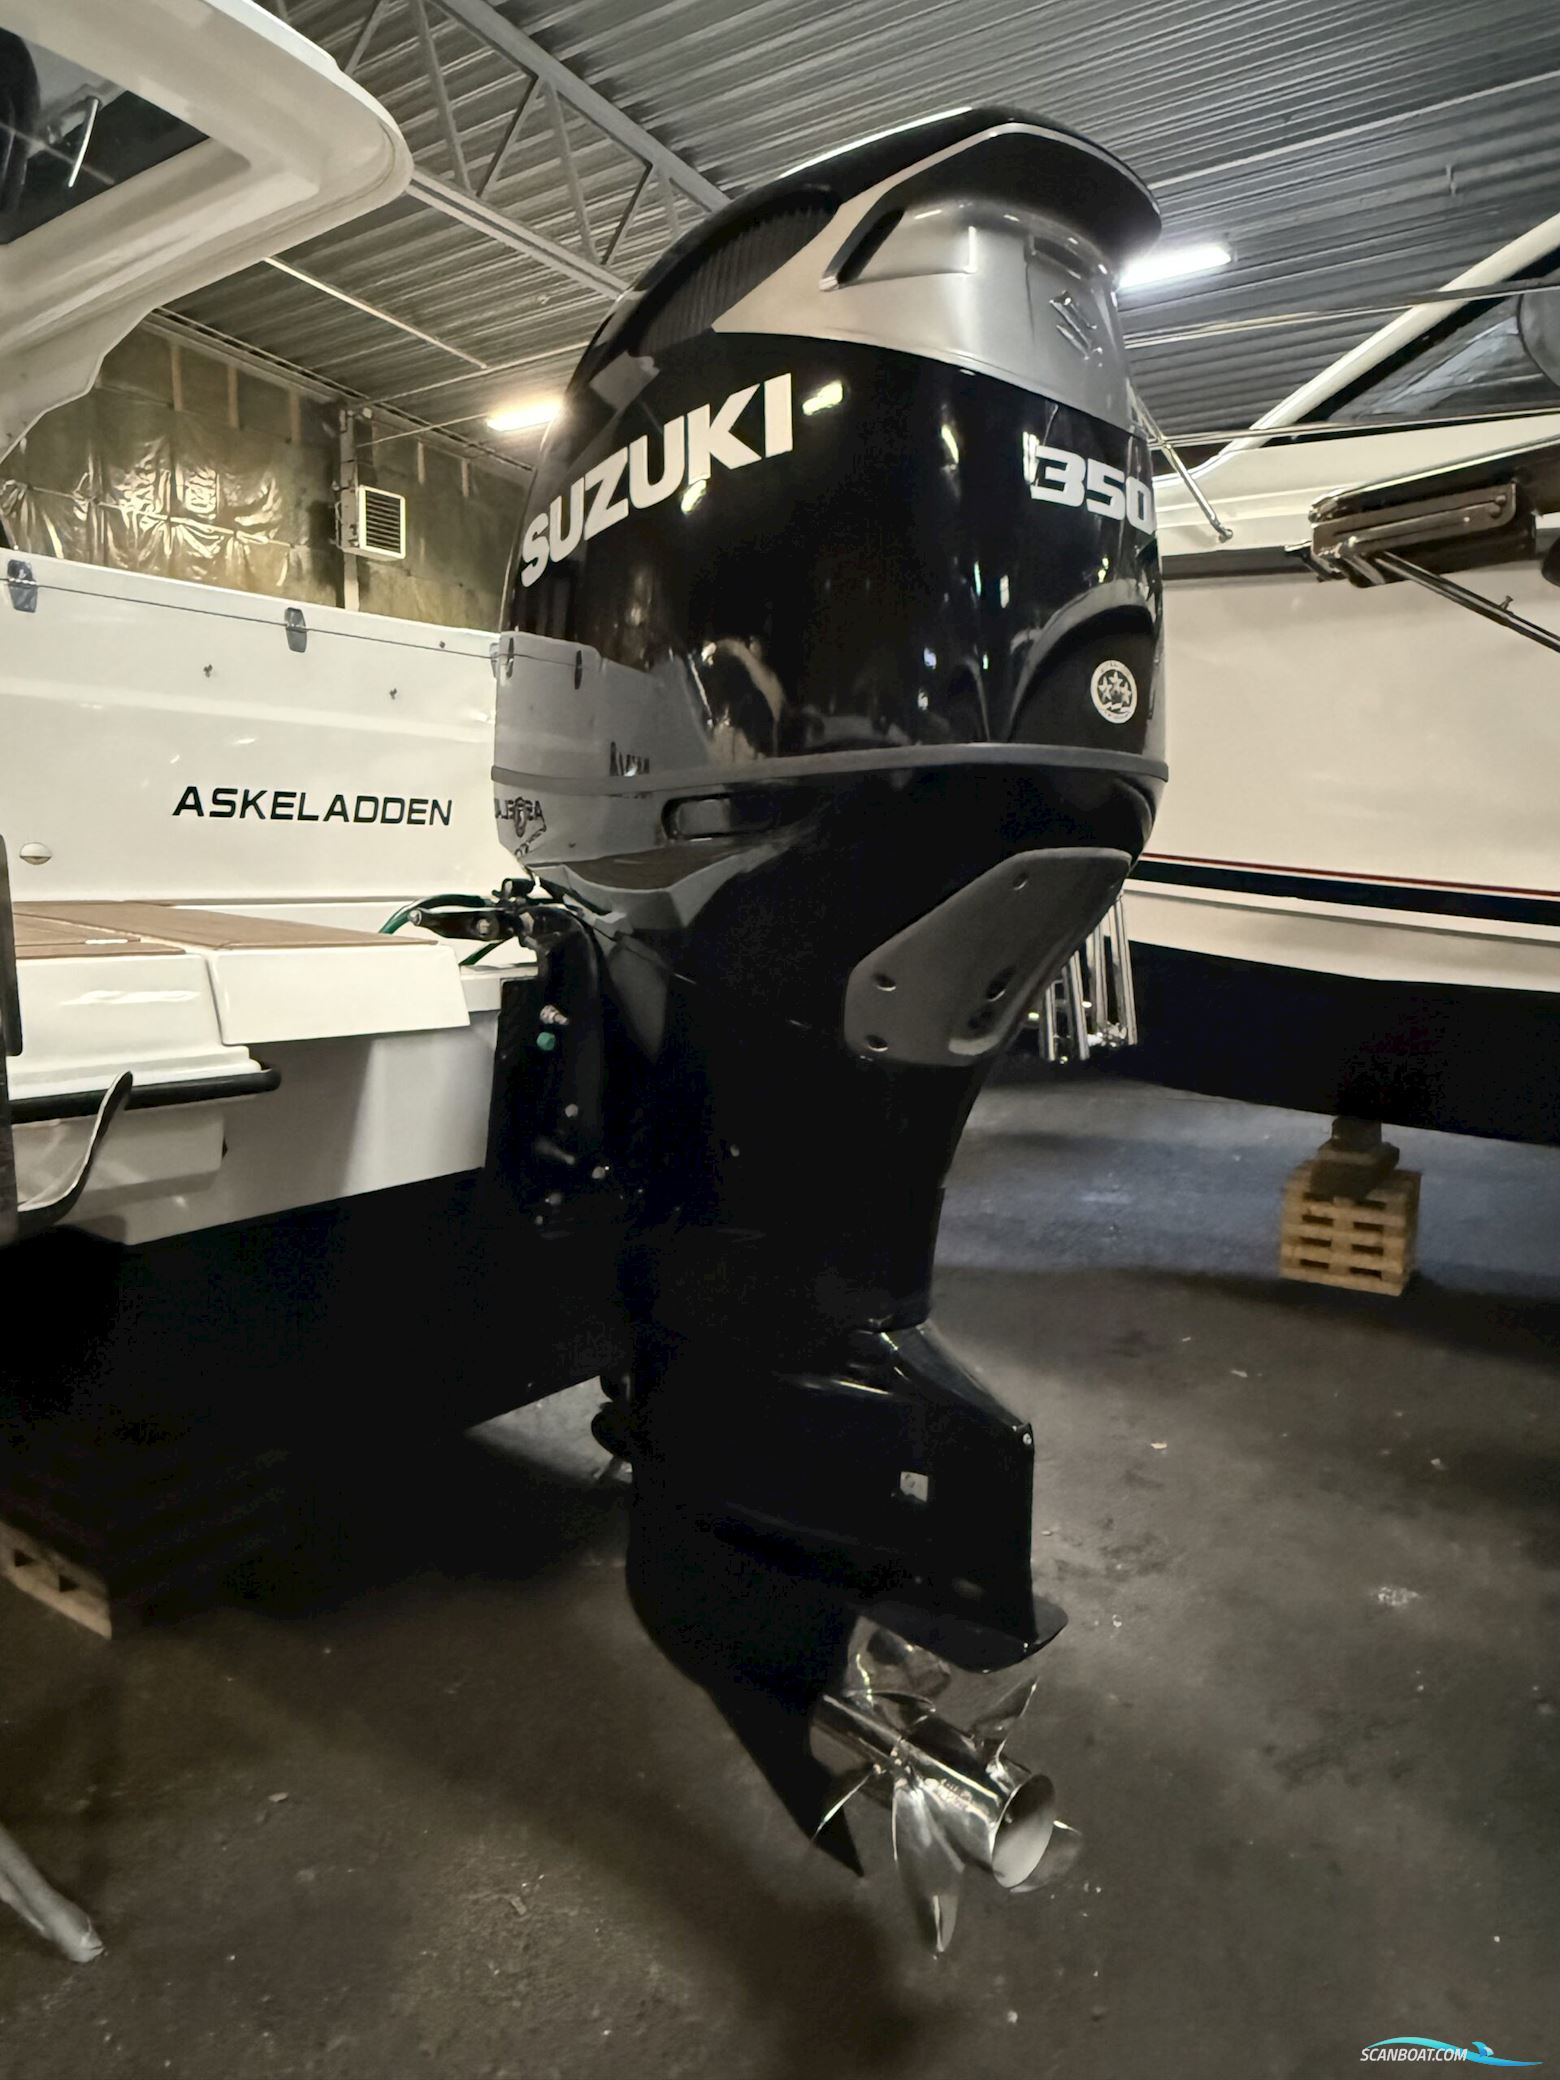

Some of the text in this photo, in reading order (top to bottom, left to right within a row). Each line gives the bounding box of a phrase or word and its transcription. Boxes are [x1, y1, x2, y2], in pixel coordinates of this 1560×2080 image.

[521, 373, 793, 587] SUZUKI
[1030, 445, 1156, 535] 350
[172, 786, 453, 826] ASKELADDEN
